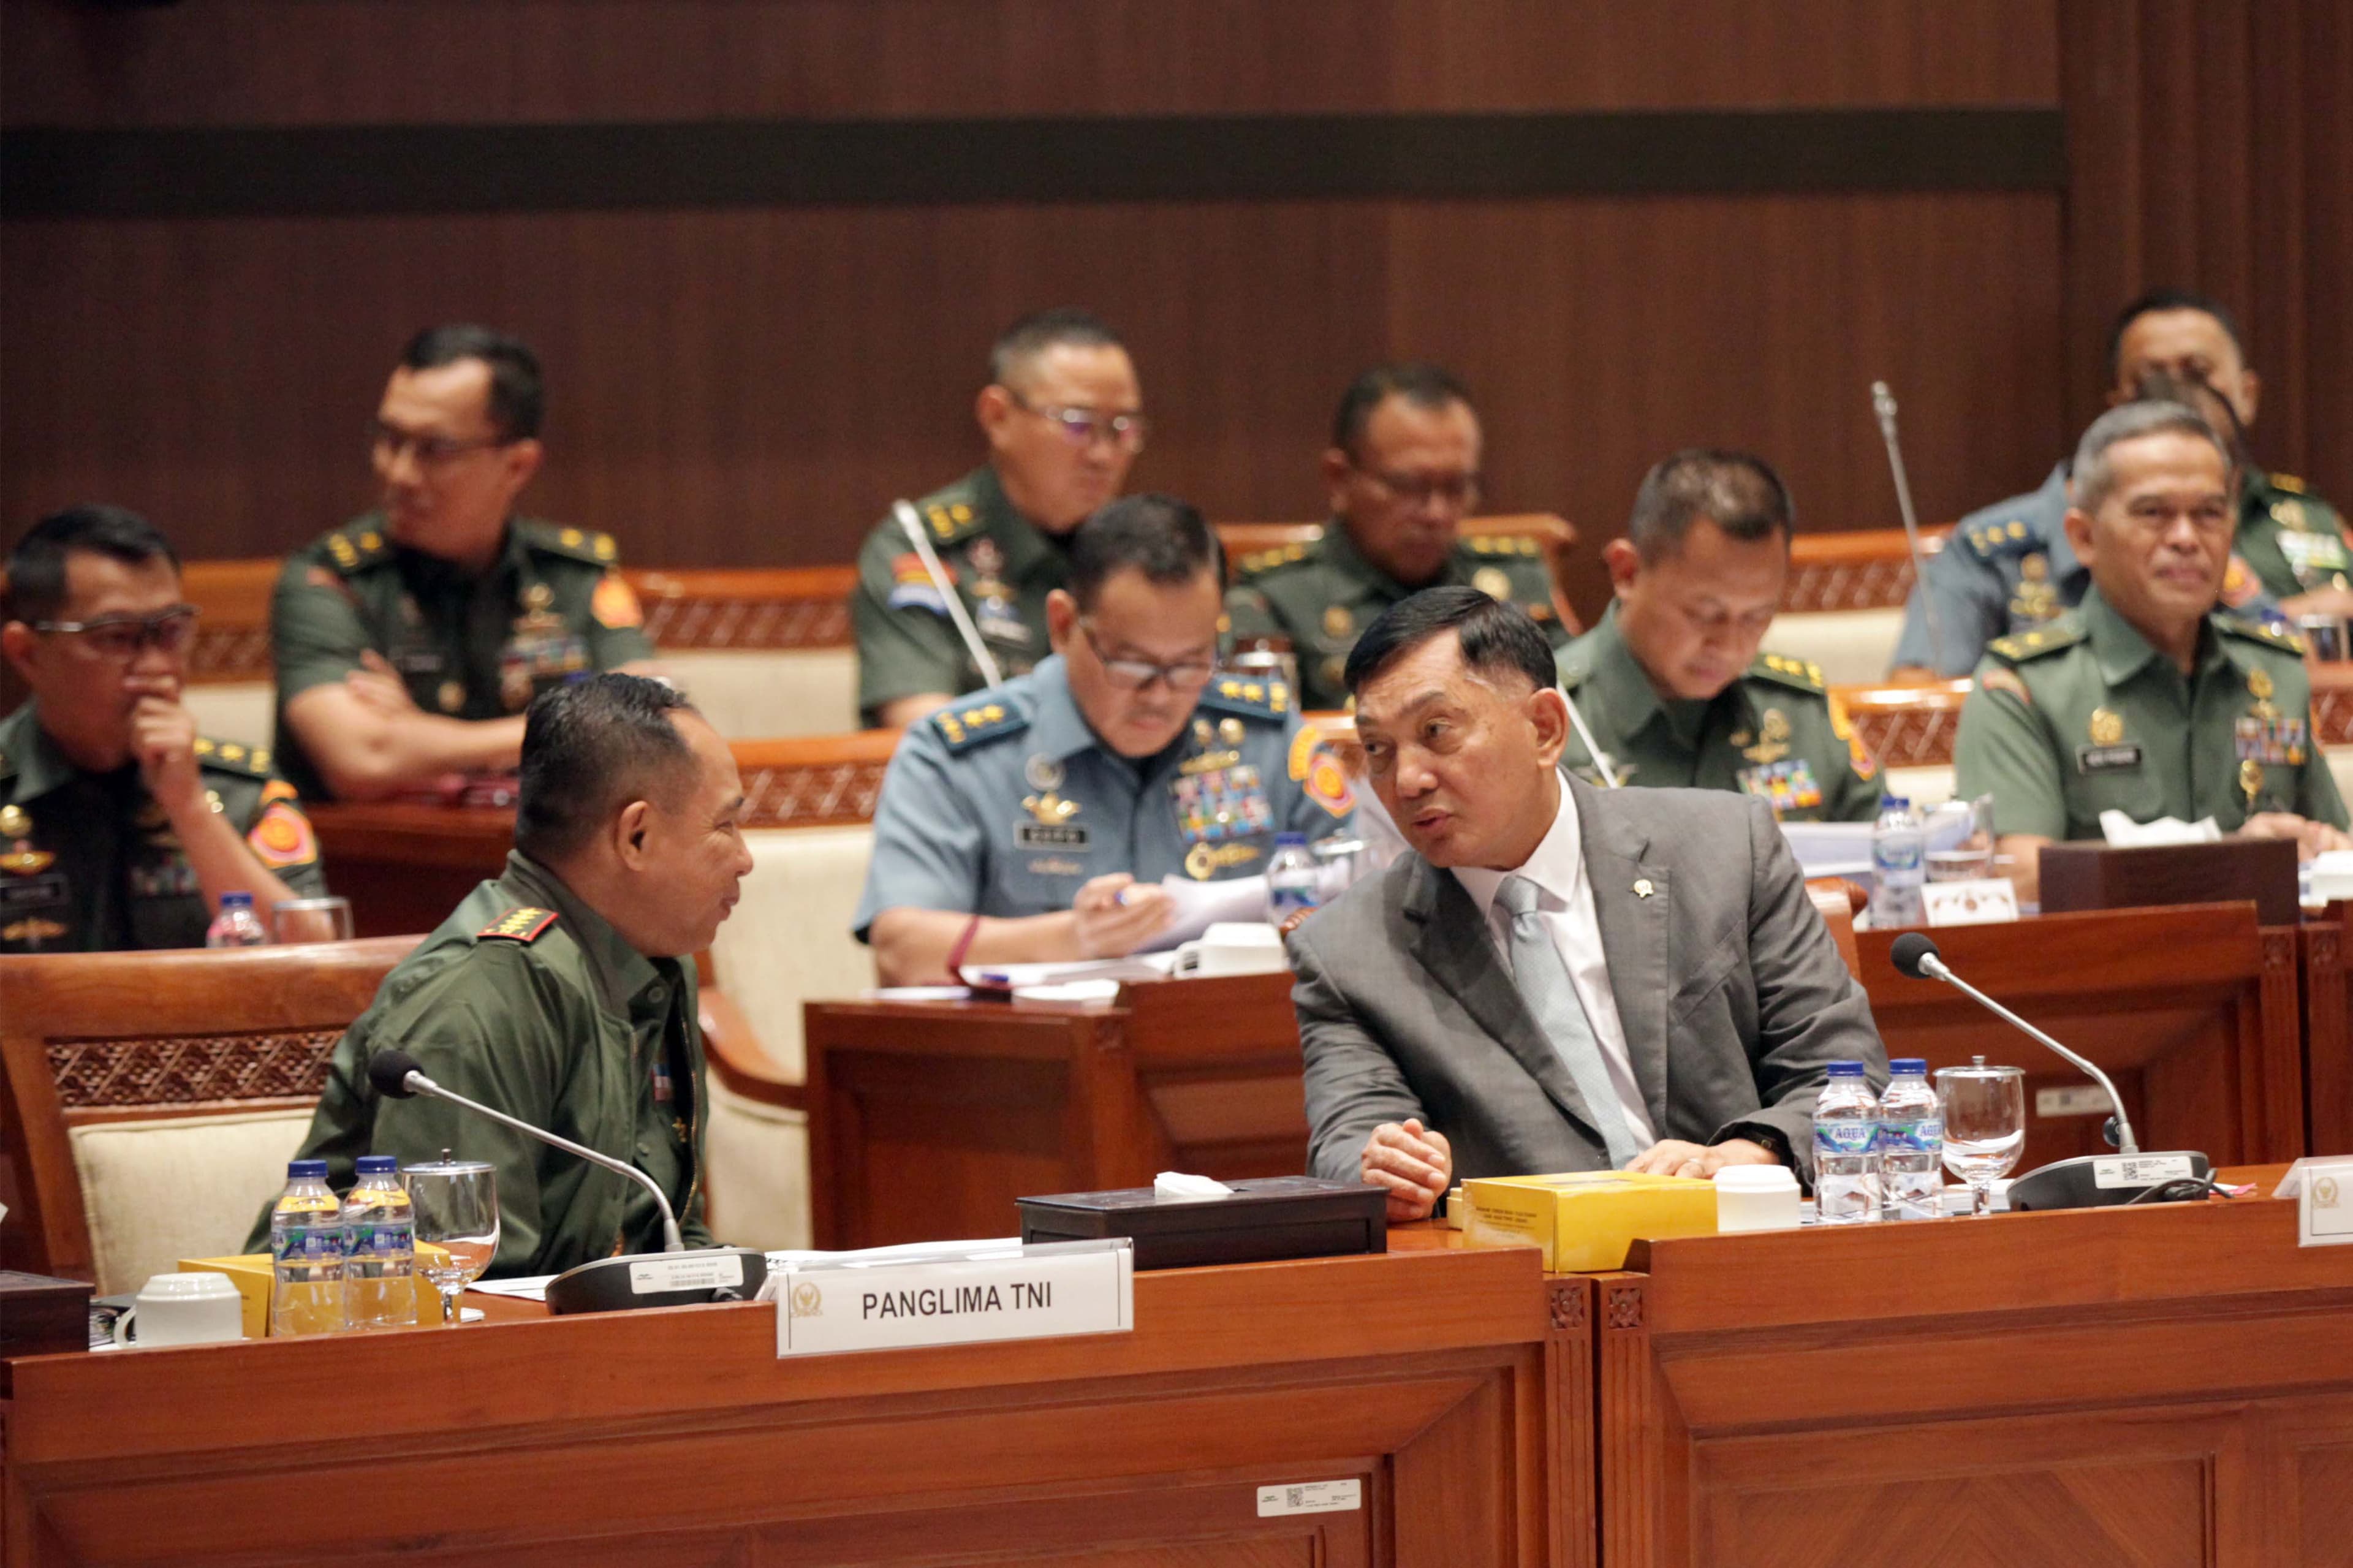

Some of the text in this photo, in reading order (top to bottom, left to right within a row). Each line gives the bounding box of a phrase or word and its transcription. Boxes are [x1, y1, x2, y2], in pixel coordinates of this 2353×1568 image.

[1835, 1127, 1865, 1141] AQUA
[863, 1281, 1051, 1320] PANGLIMA TNI
